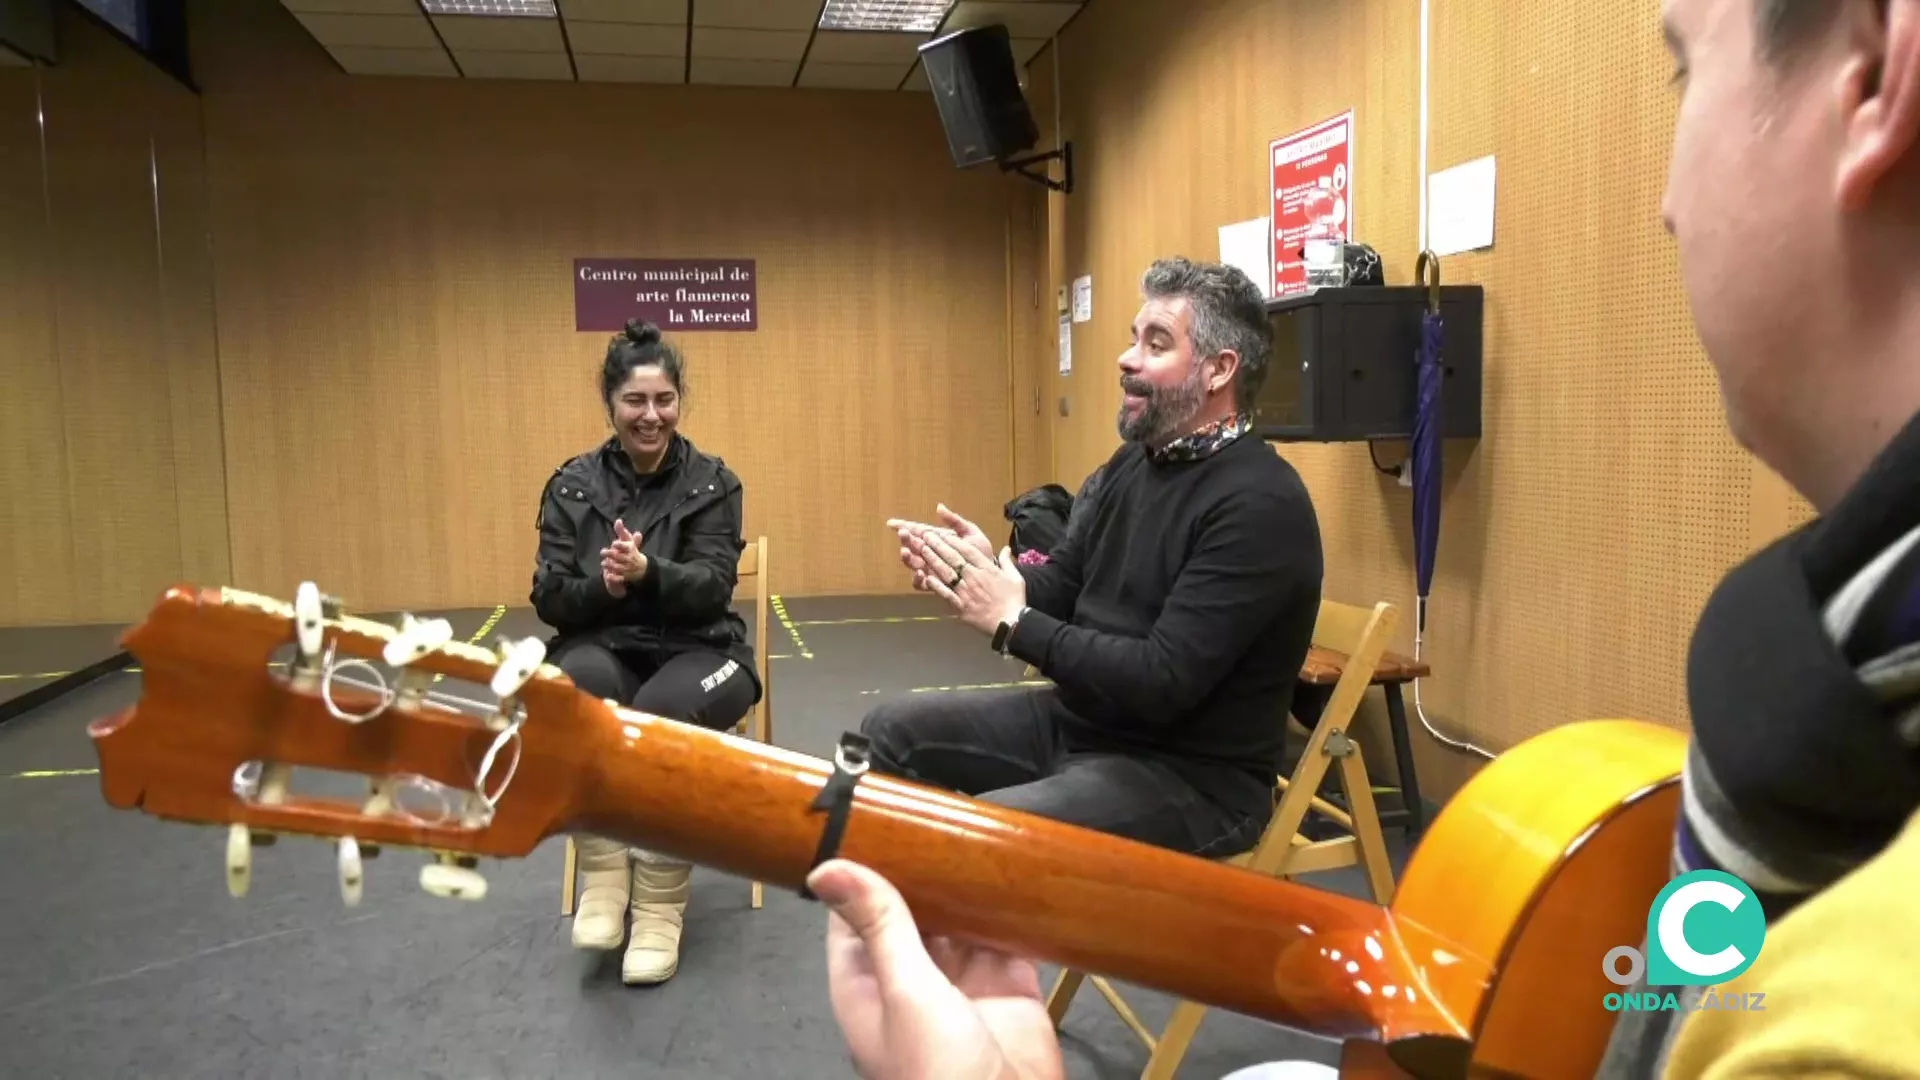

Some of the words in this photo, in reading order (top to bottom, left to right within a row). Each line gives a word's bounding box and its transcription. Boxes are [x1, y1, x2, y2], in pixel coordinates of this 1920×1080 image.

[579, 266, 637, 281] Centro
[643, 267, 725, 284] municipal
[730, 267, 750, 281] de
[636, 290, 670, 302] arte
[675, 288, 751, 302] flamenco
[669, 309, 684, 323] la
[690, 309, 751, 323] Merced
